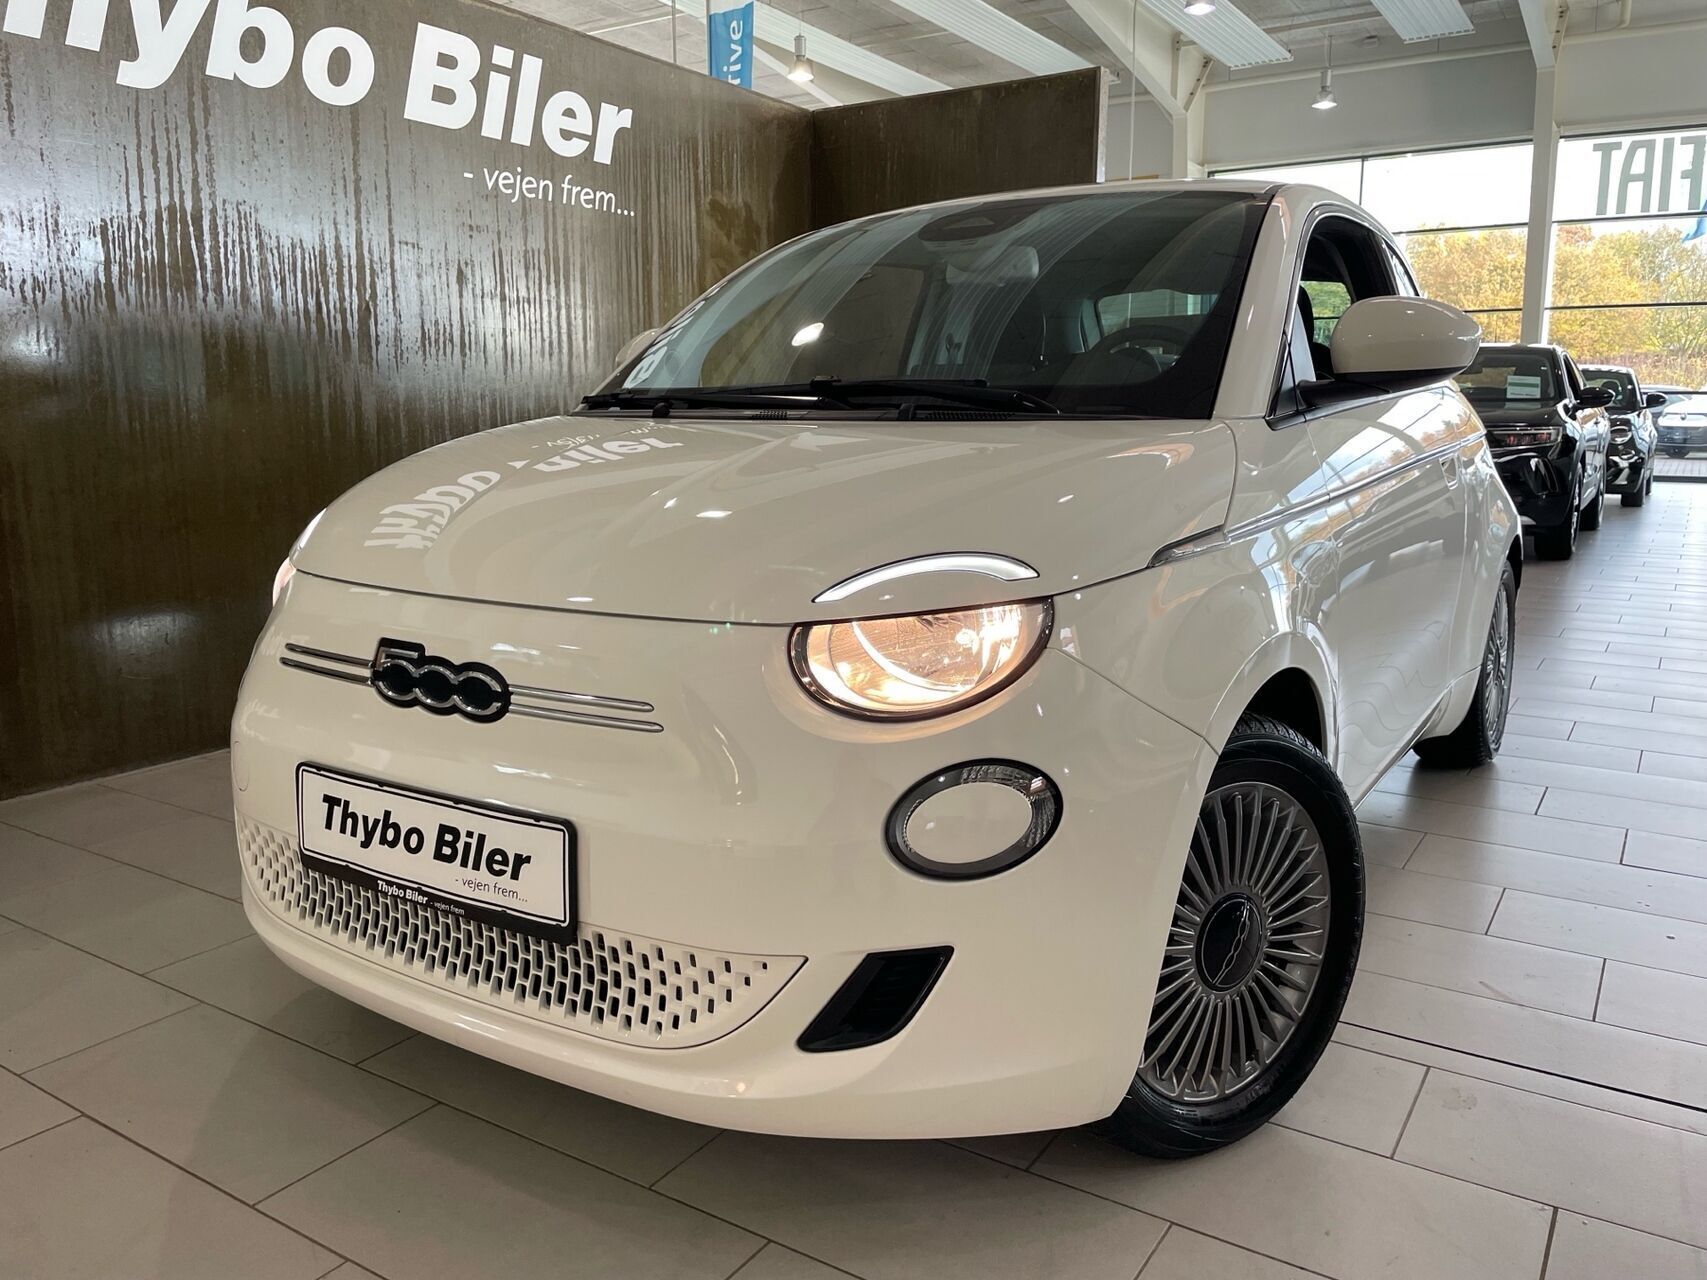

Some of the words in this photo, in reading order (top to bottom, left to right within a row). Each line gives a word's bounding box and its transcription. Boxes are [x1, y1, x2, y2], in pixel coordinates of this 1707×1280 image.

[403, 22, 633, 165] Biler
[483, 166, 553, 203] vejen
[561, 174, 635, 217] frem...
[373, 637, 512, 723] 500
[322, 793, 425, 855] Thybo
[432, 823, 532, 881] Biler
[377, 880, 404, 897] Thybo
[405, 889, 428, 904] Biler
[462, 877, 490, 893] vejen
[493, 881, 528, 903] frem...
